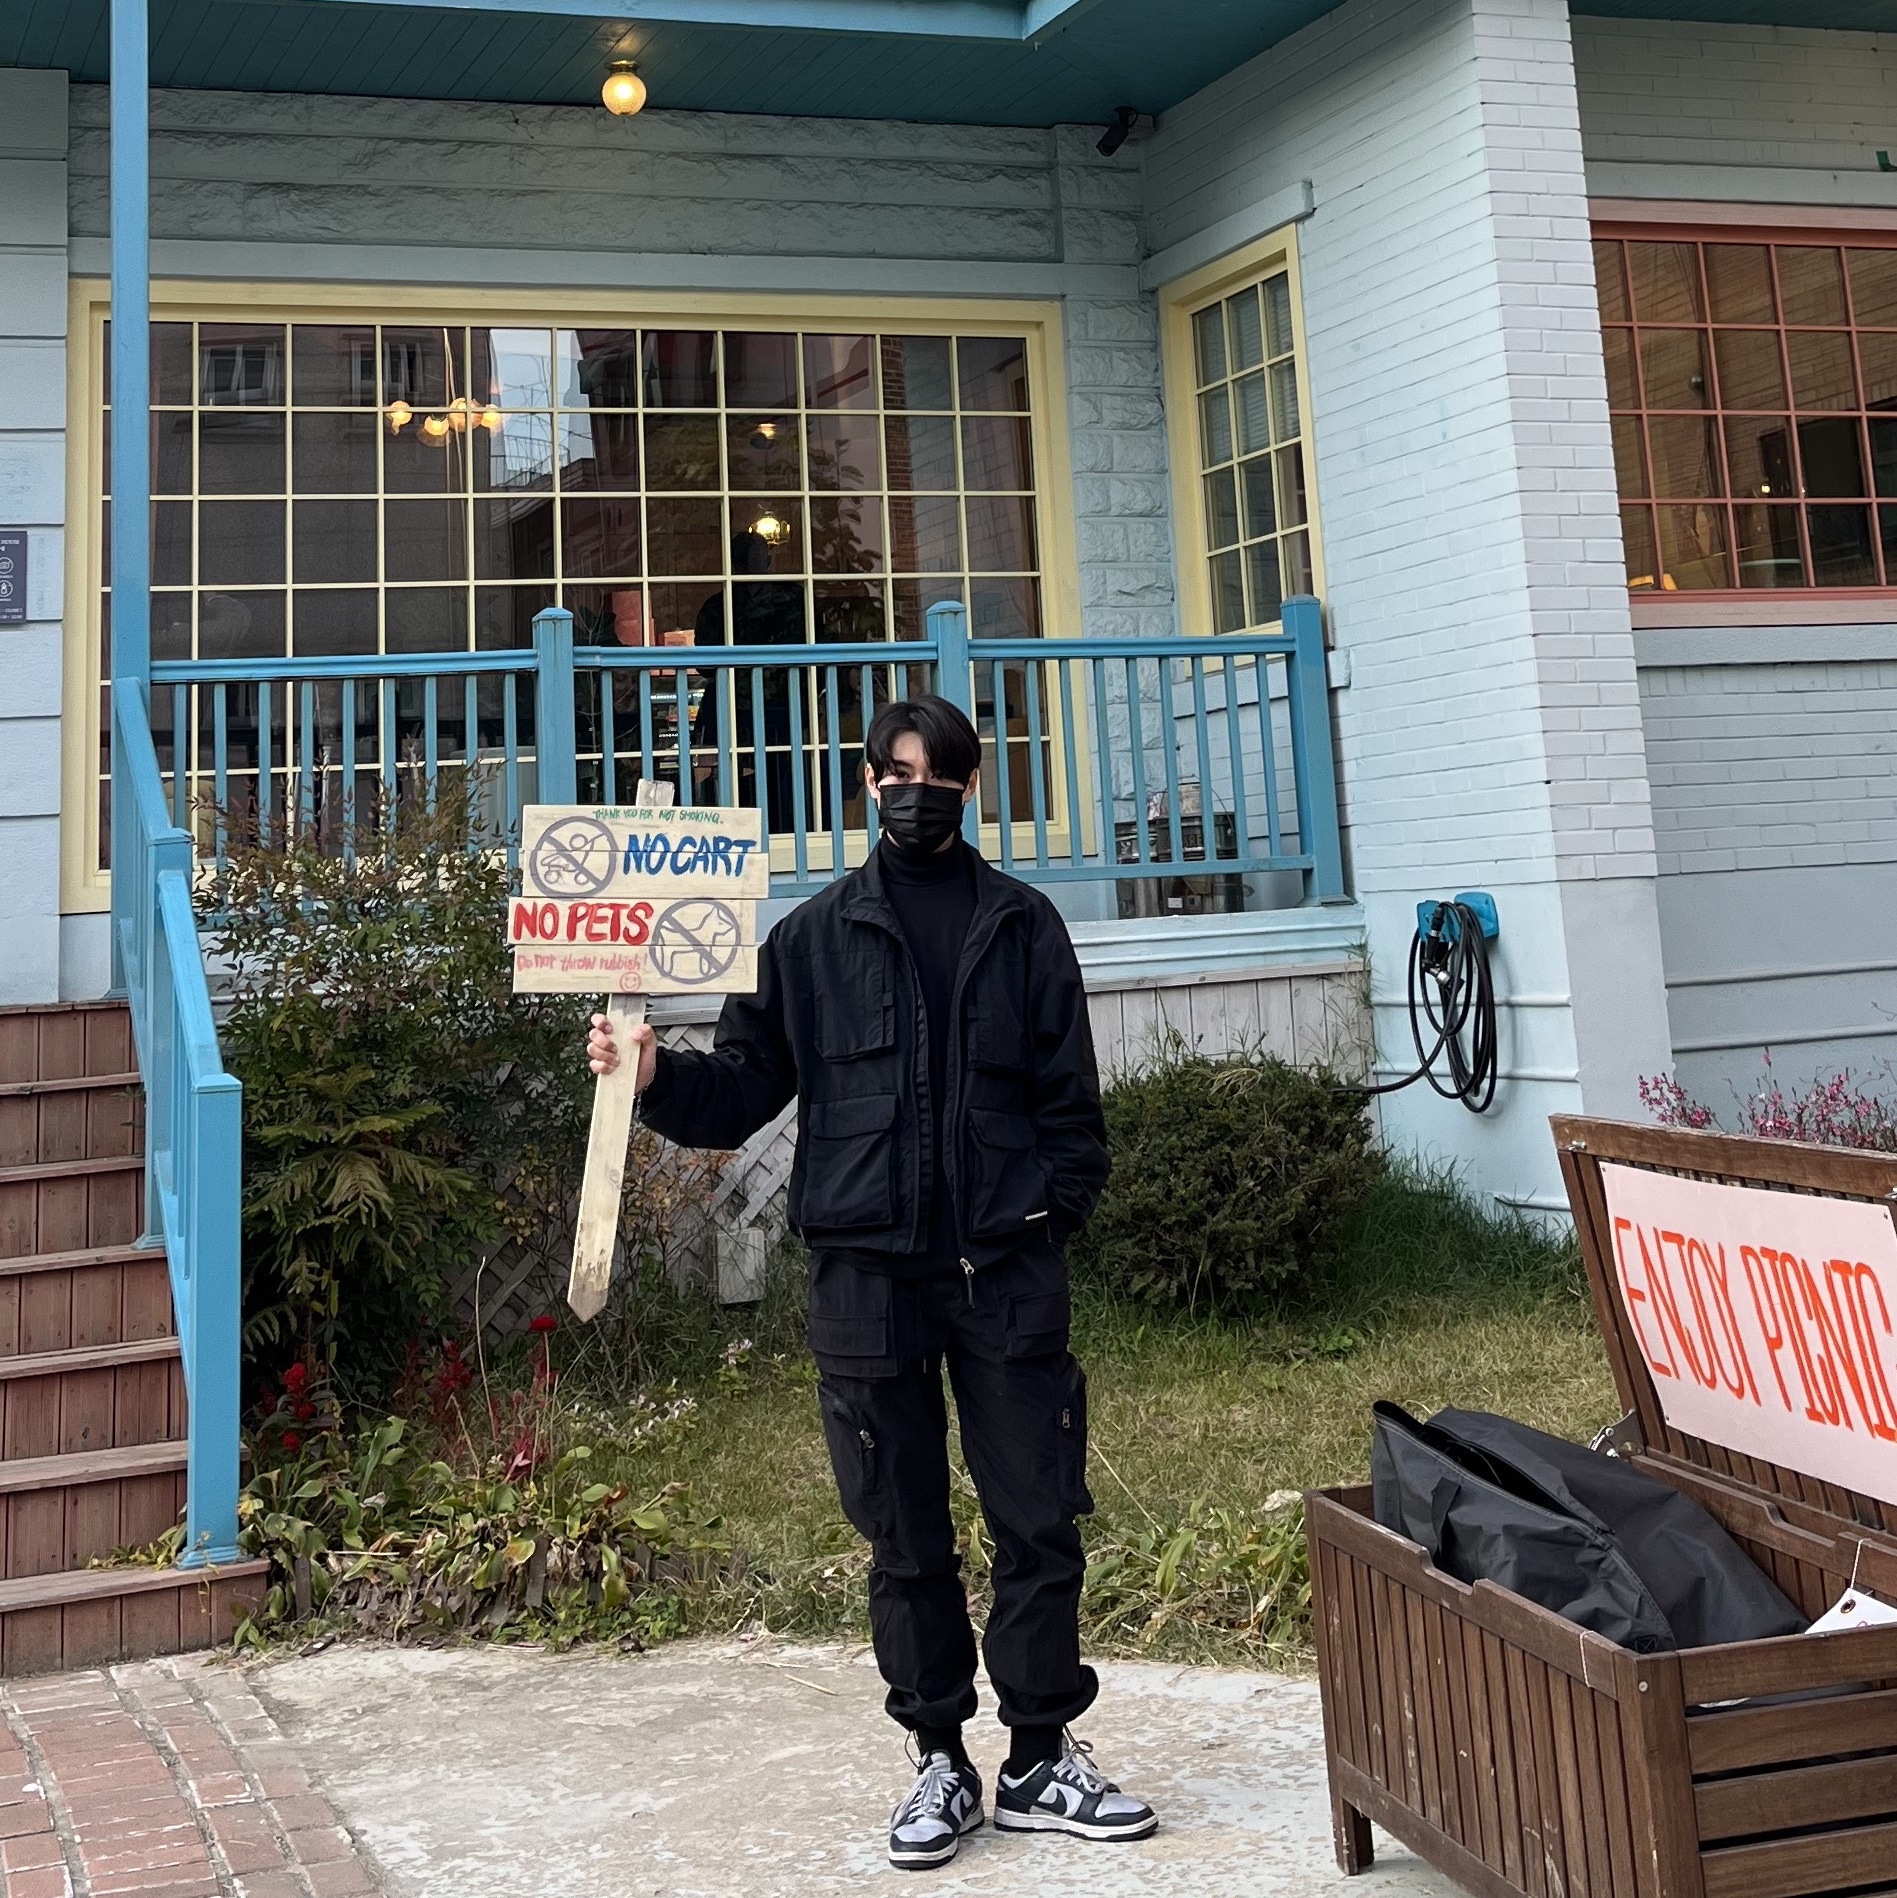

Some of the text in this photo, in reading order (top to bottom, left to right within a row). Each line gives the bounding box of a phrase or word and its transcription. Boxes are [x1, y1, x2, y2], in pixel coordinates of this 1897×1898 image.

[623, 808, 638, 819] YOU
[659, 809, 676, 822] NOT
[623, 832, 757, 878] NO CART
[513, 901, 655, 946] NO PETS
[1613, 1215, 1762, 1408] ENJOY
